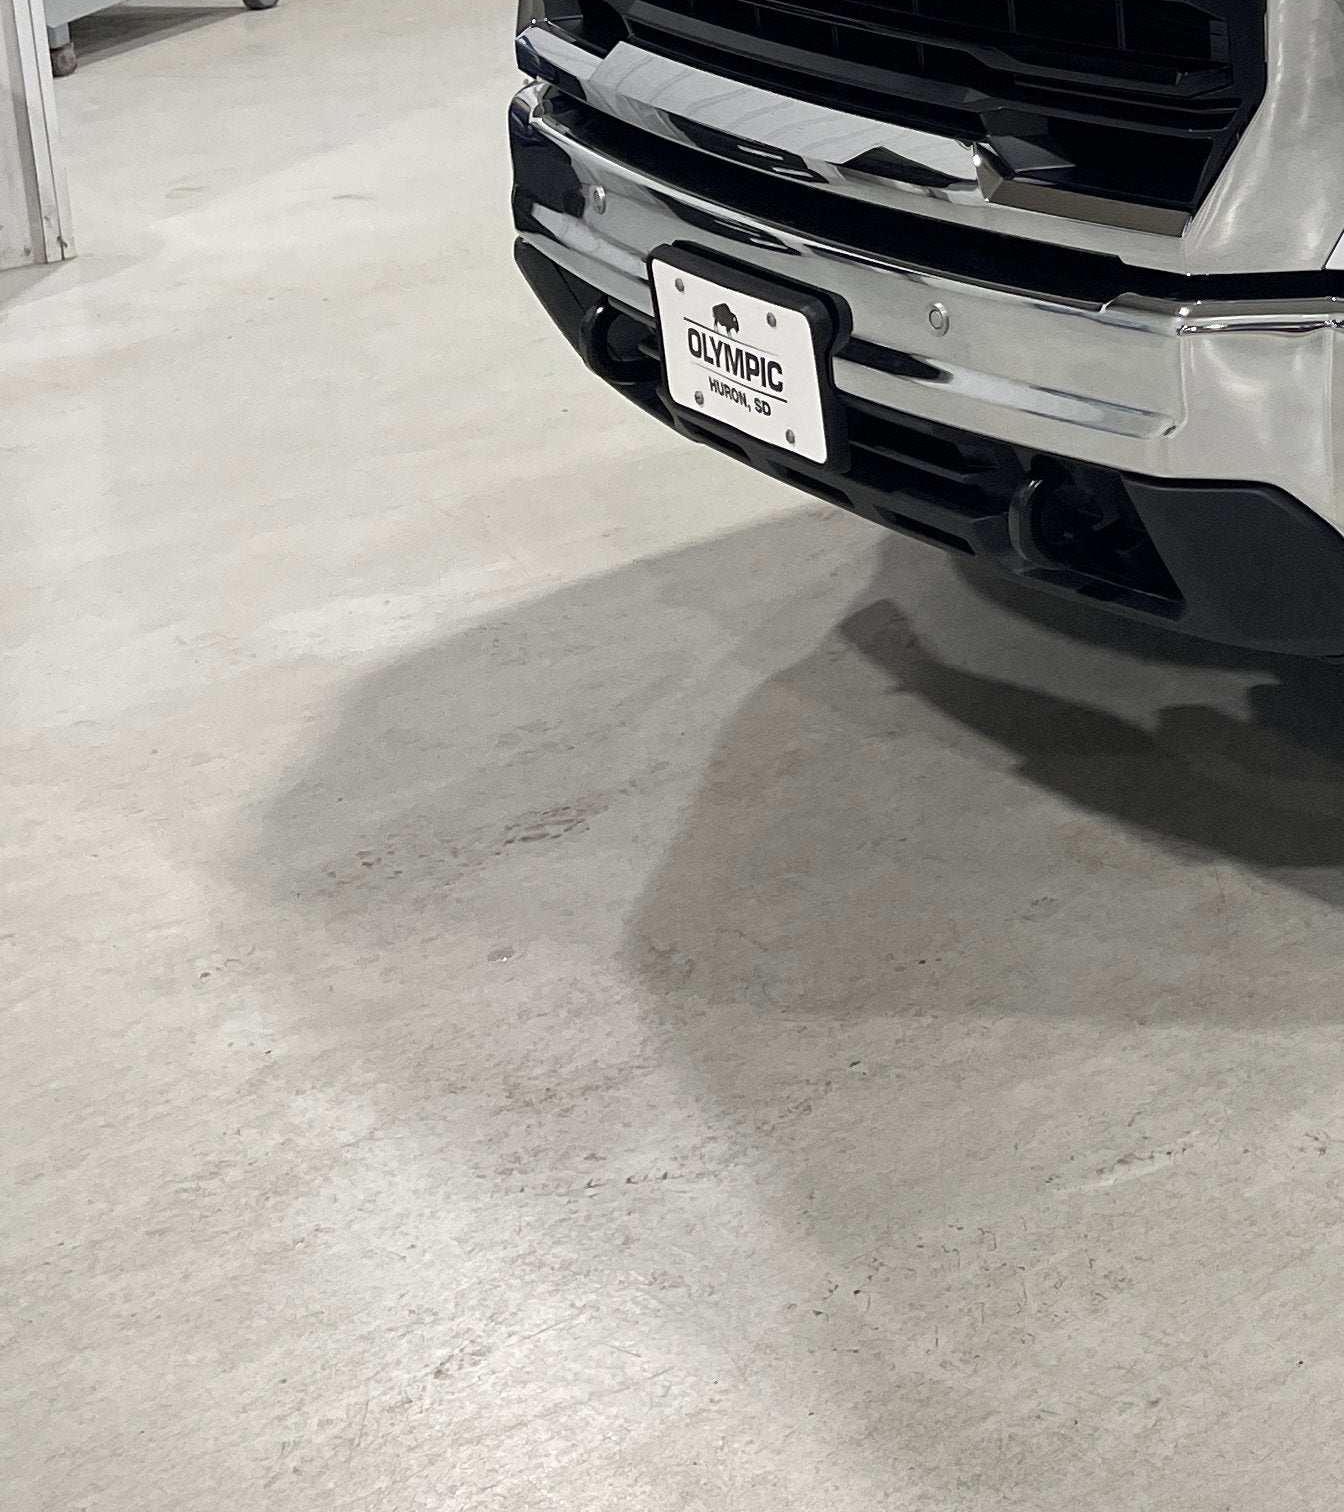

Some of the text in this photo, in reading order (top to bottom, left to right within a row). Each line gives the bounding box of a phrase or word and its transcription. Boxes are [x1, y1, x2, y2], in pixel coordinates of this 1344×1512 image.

[687, 327, 784, 392] OLYMPIC
[709, 376, 771, 416] HURON, SD
